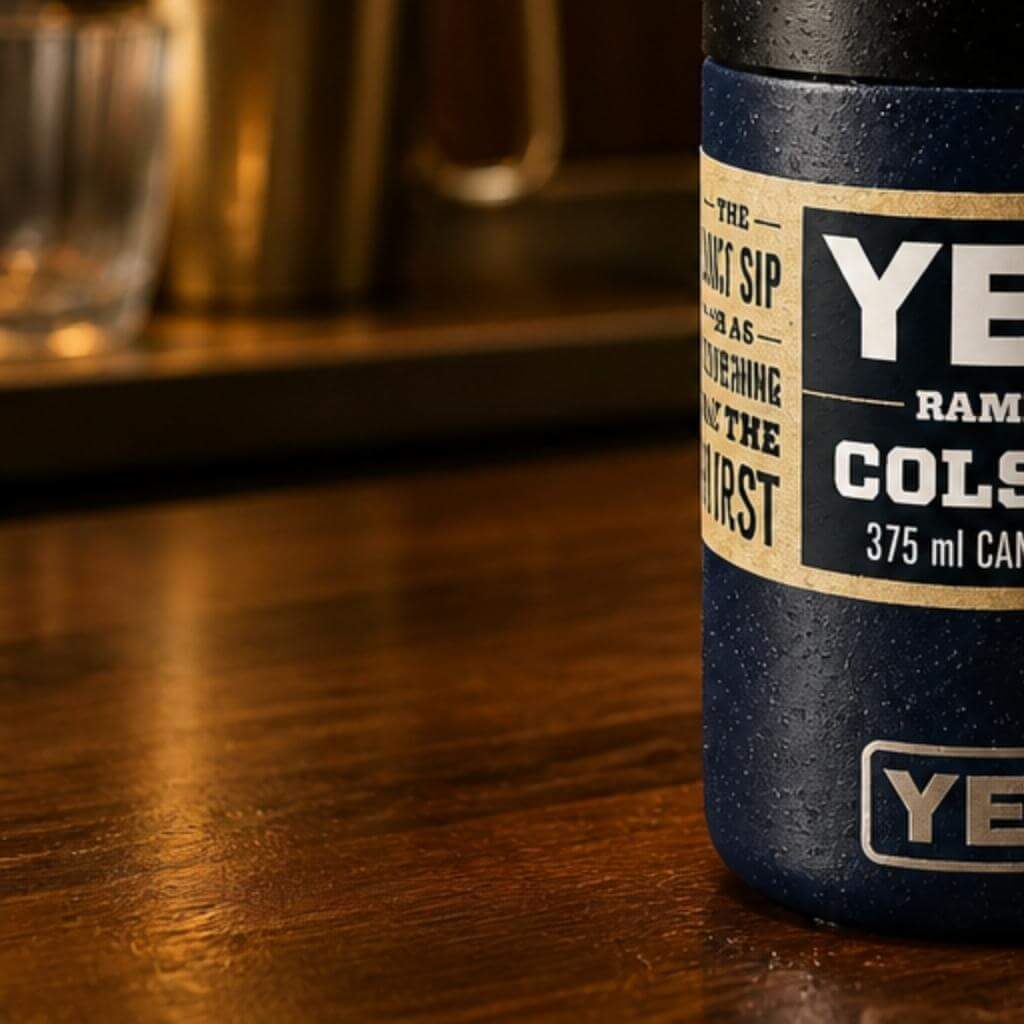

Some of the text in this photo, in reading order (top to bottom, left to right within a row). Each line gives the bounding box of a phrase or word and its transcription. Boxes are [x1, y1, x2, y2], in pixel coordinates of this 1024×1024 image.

[717, 197, 749, 230] THE
[739, 246, 781, 309] SIP
[729, 317, 754, 344] AS
[725, 405, 780, 457] THE
[866, 522, 918, 566] 375
[931, 529, 964, 568] ml
